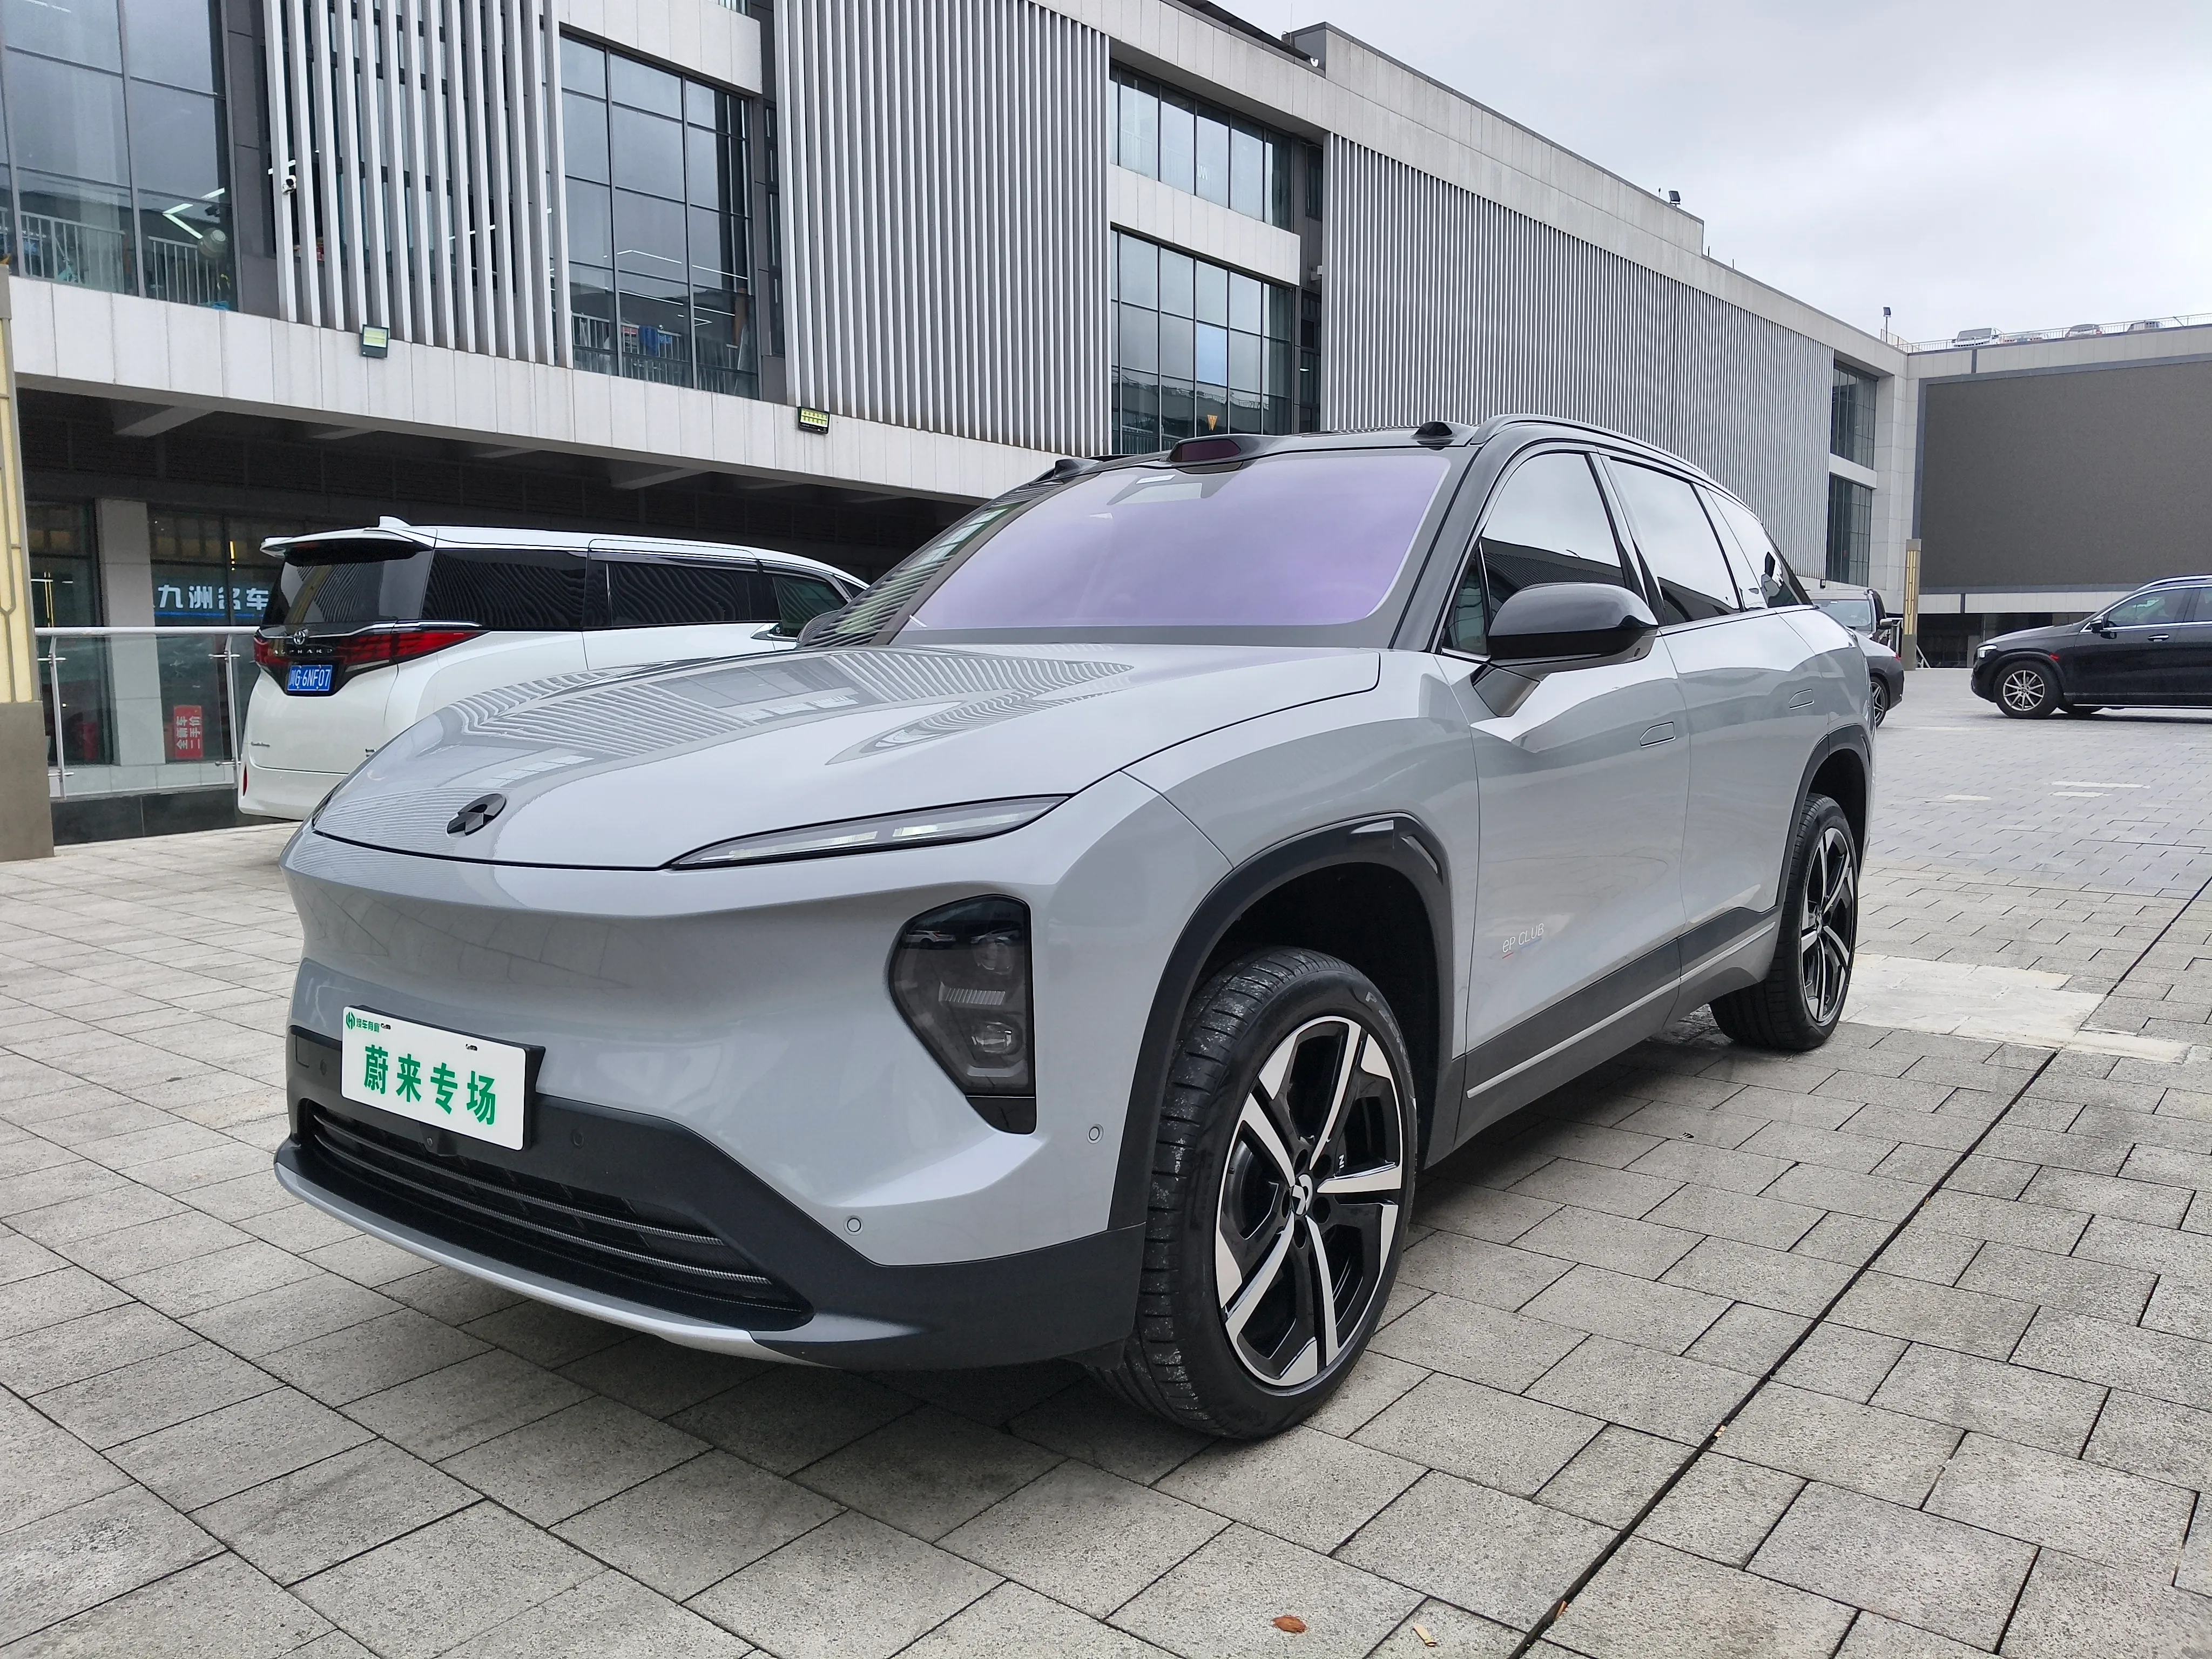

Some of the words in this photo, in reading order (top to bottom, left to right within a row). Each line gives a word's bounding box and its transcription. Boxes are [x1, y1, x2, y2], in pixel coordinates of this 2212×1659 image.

[158, 584, 269, 610] 九洲名车
[1519, 923, 1544, 945] CLUB
[1365, 992, 1377, 1003] P
[364, 1044, 496, 1125] 蔚来专场
